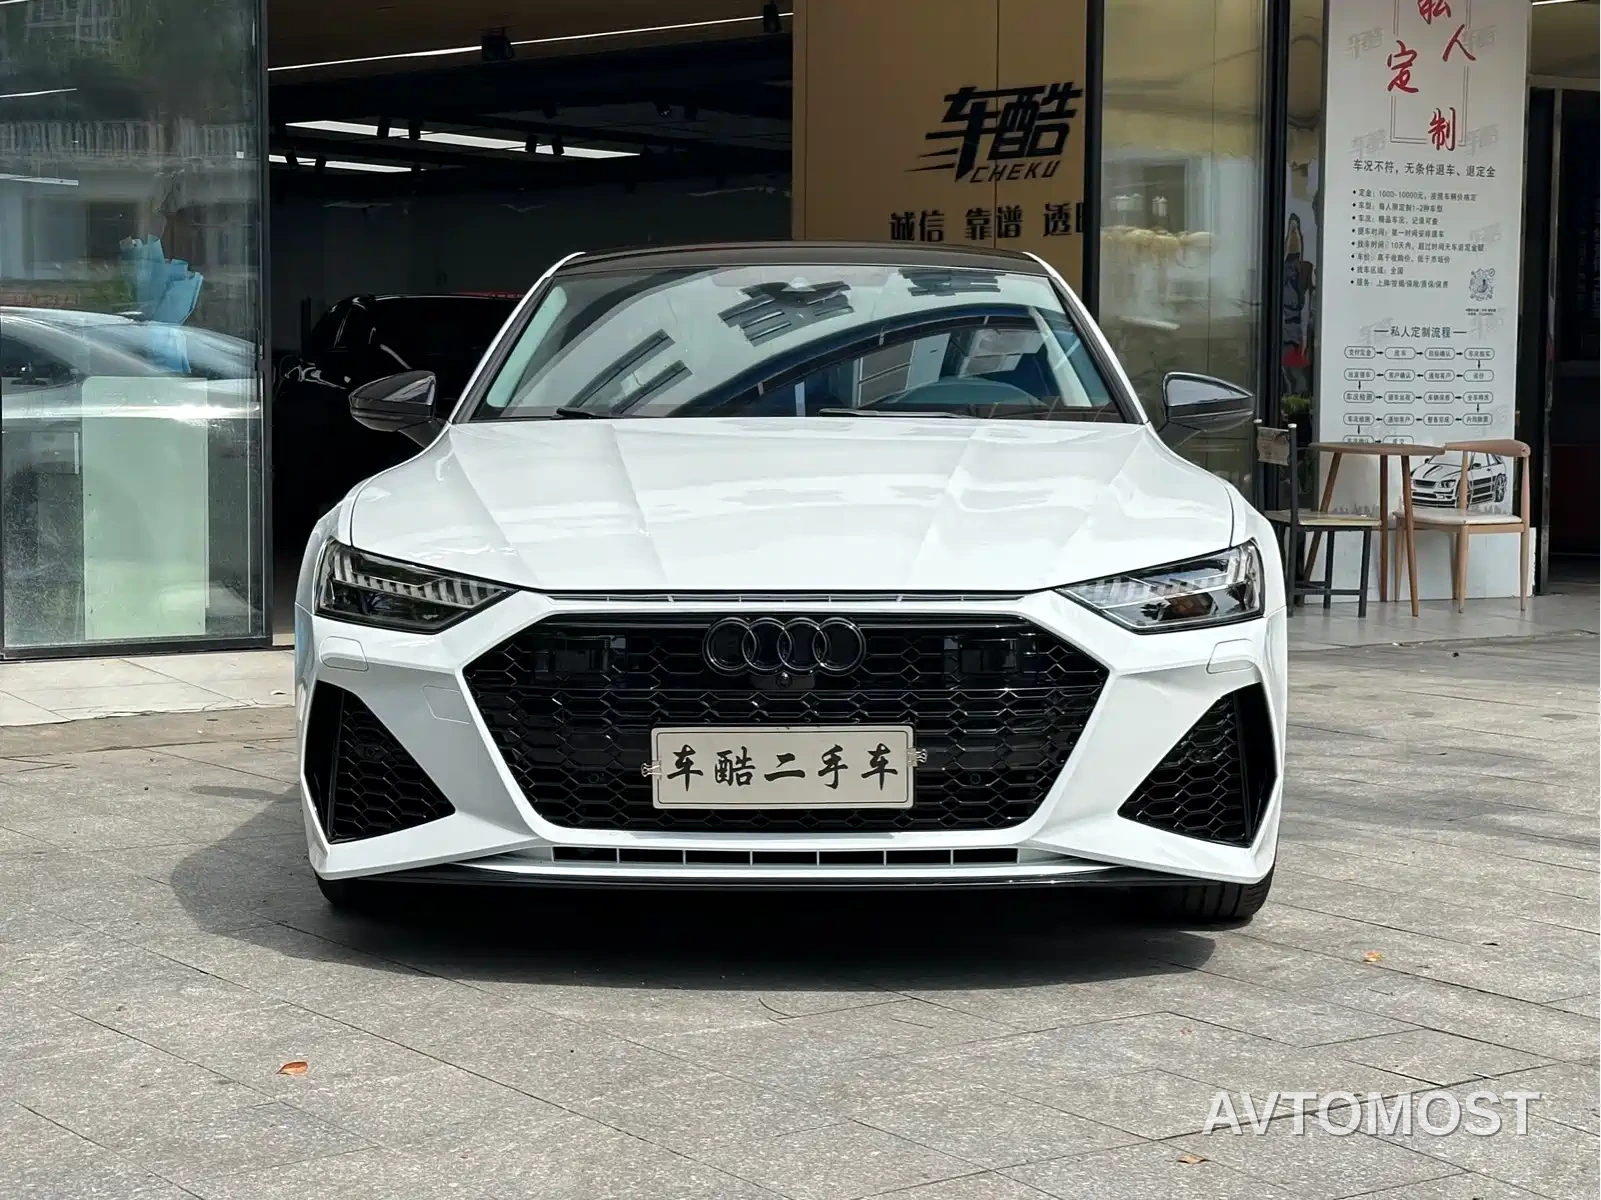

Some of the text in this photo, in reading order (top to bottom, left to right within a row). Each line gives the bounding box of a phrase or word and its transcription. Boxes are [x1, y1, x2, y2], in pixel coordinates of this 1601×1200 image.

[1442, 24, 1476, 62] 人
[1386, 40, 1419, 94] 定
[905, 82, 1083, 183] 车酷
[1427, 106, 1456, 152] 制
[970, 160, 1061, 184] CHEKU
[890, 202, 1084, 242] 诚信 靠谱 透
[1390, 326, 1451, 339] 私人定制流程
[667, 744, 898, 792] 车酷二手车
